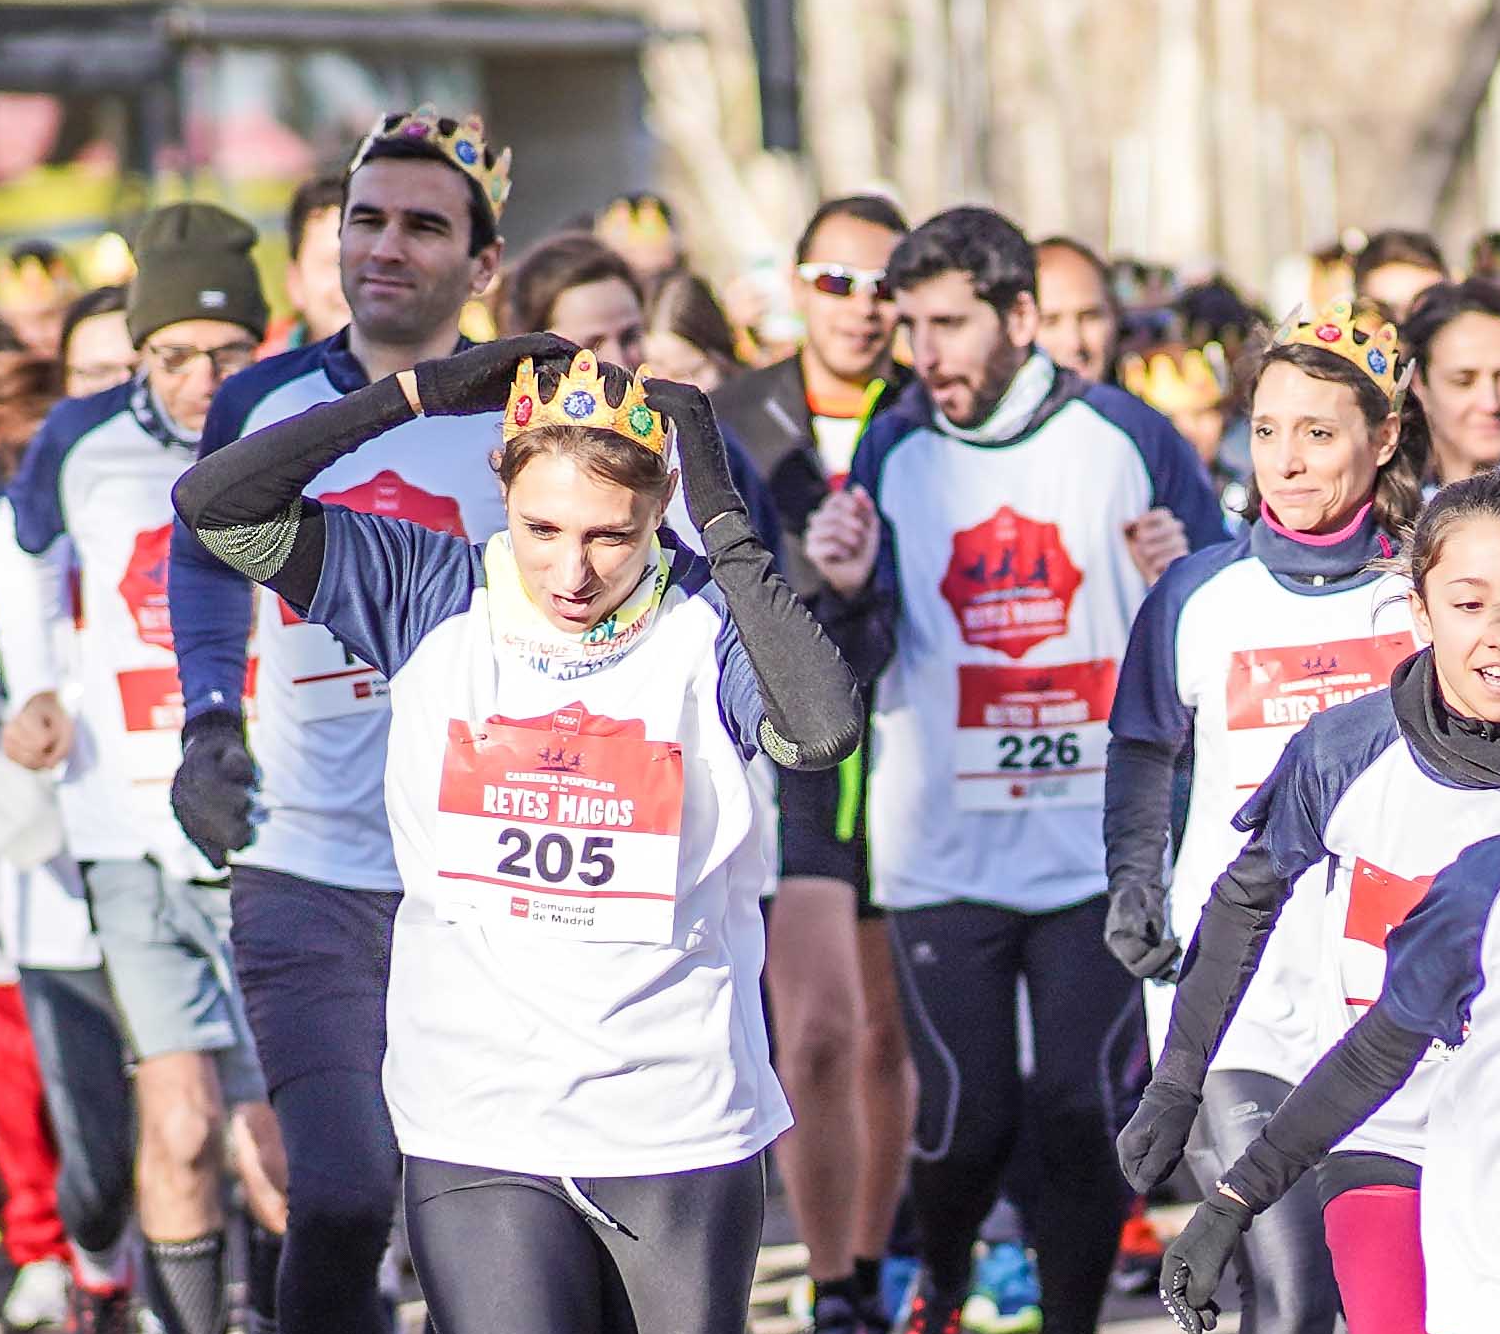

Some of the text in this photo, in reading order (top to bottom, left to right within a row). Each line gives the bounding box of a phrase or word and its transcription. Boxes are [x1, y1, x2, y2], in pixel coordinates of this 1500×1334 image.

[997, 731, 1081, 771] 226
[483, 784, 634, 828] REYES MAGOS
[496, 827, 616, 887] 205
[532, 899, 596, 915] Comunidad
[532, 911, 595, 927] de Madrid
